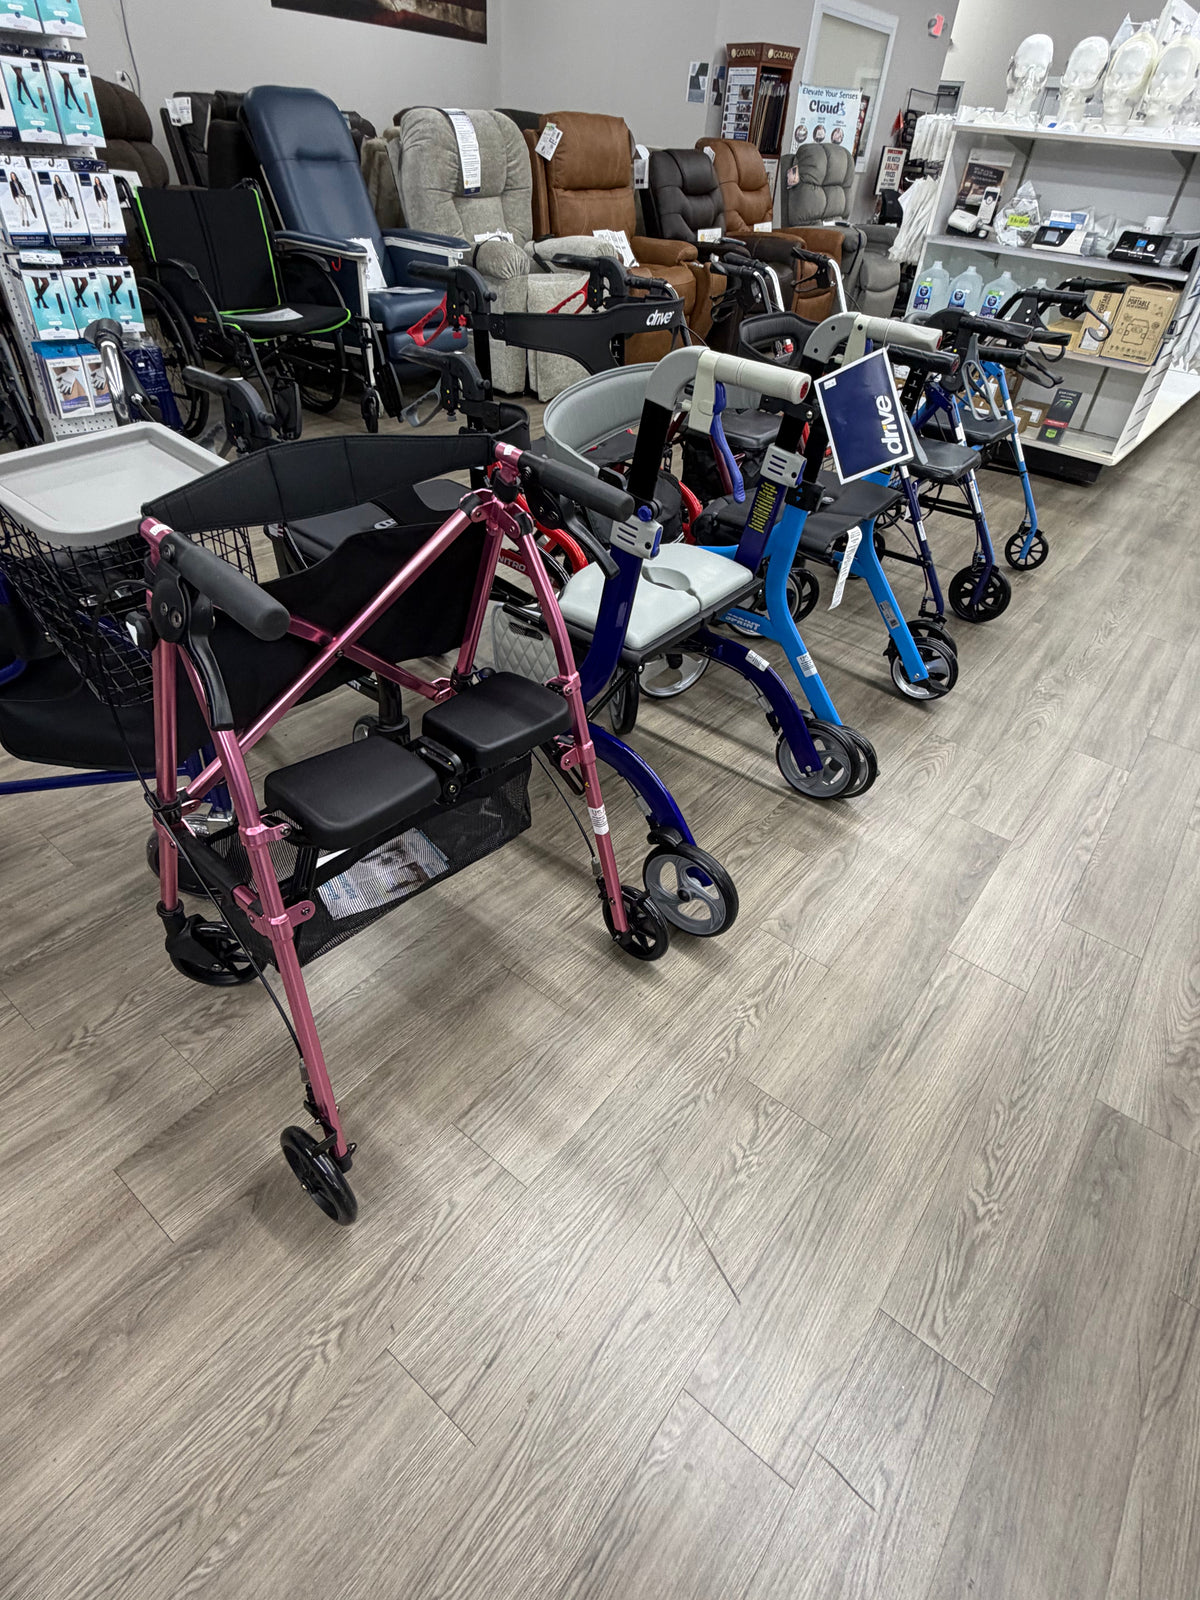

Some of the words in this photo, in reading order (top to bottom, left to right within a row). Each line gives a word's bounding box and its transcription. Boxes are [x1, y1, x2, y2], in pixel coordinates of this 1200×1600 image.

[737, 49, 756, 57] GOLDEN
[773, 50, 794, 60] GOLDEN
[803, 87, 824, 97] Elevate
[840, 91, 858, 100] Senses
[809, 100, 839, 114] Cloud
[1128, 298, 1150, 308] PORTABLE
[646, 309, 673, 326] drive
[876, 395, 903, 455] drive
[498, 555, 526, 572] NITRO
